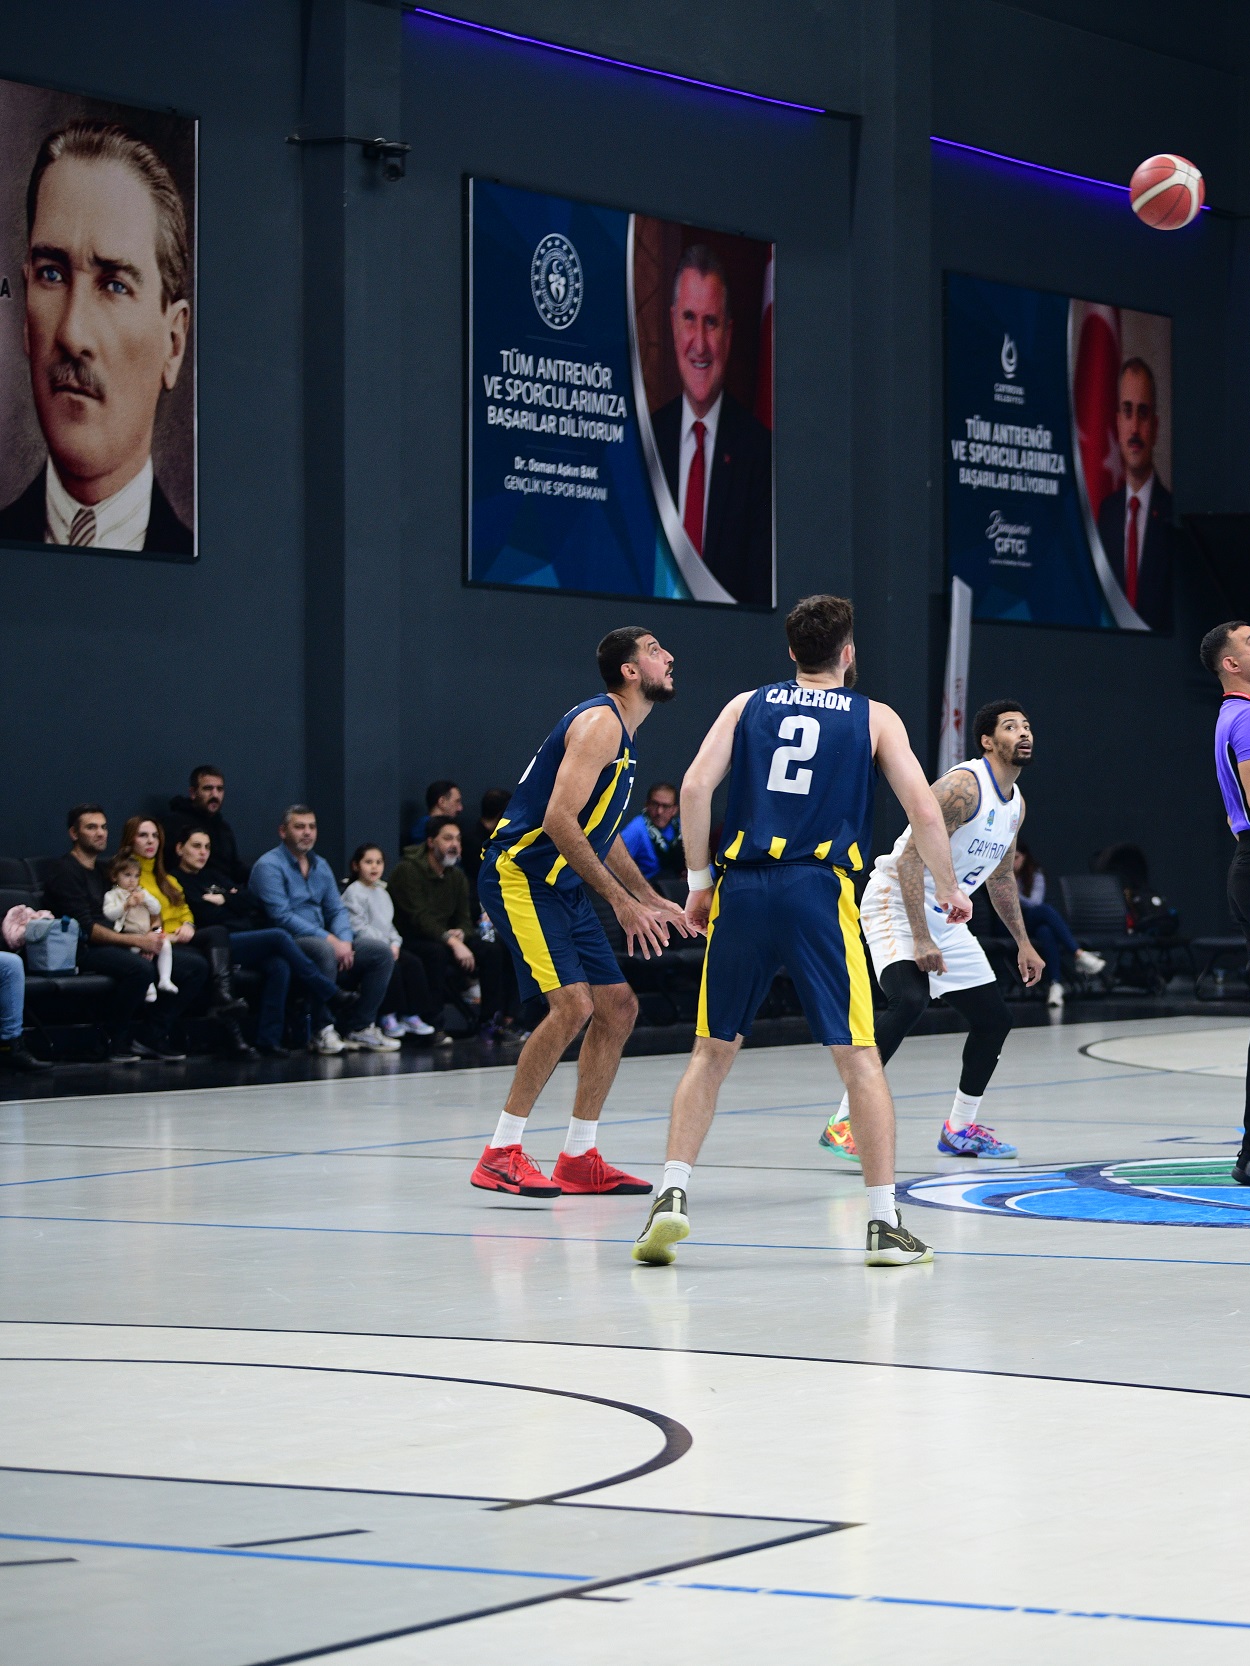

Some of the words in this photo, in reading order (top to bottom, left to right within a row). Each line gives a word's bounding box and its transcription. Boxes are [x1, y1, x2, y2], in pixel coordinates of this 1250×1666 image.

[500, 348, 534, 377] TÜM
[536, 357, 613, 389] ANTRENÖR
[483, 374, 503, 399] VE
[505, 378, 627, 418] SPORCULARIMIZA
[487, 405, 557, 434] BAŞARILAR
[559, 414, 625, 443] DİLİYORUM
[965, 414, 991, 440] TÜM
[992, 422, 1053, 449] ANTRENÖR
[514, 456, 528, 470] Dr.
[528, 458, 557, 475] Osman
[951, 440, 968, 461] VE
[969, 442, 1066, 474] SPORCULARIMIZA
[553, 481, 576, 498] SPOR
[959, 468, 1009, 490] BAŞARILAR
[1010, 472, 1059, 495] DİLİYORUM
[765, 687, 853, 712] CAMERON
[766, 715, 821, 795] 2
[963, 866, 985, 886] 2
